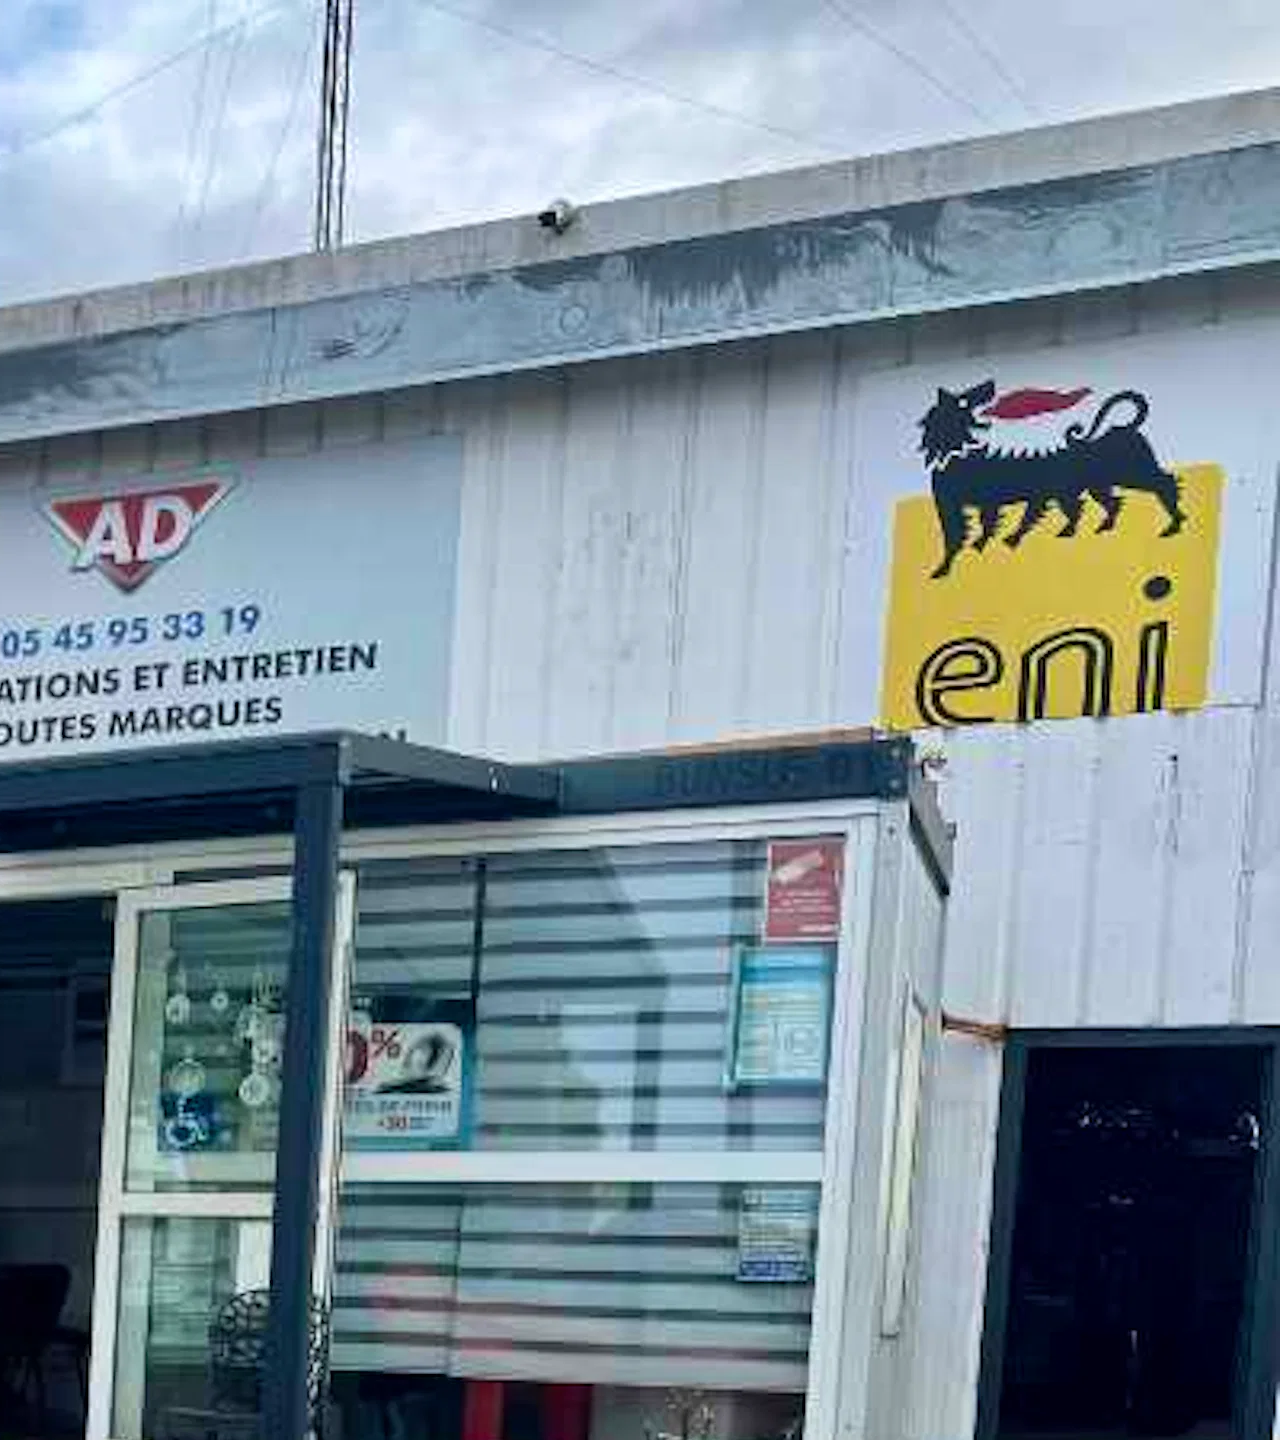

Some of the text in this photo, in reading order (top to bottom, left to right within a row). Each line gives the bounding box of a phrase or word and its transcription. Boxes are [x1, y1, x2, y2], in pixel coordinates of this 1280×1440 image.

[75, 494, 196, 568] AD
[0, 603, 262, 659] 05 45 95 33 19
[915, 575, 1174, 730] eni
[132, 661, 172, 692] ET
[181, 641, 379, 688] ENTRETIEN
[108, 696, 283, 735] MARQUES
